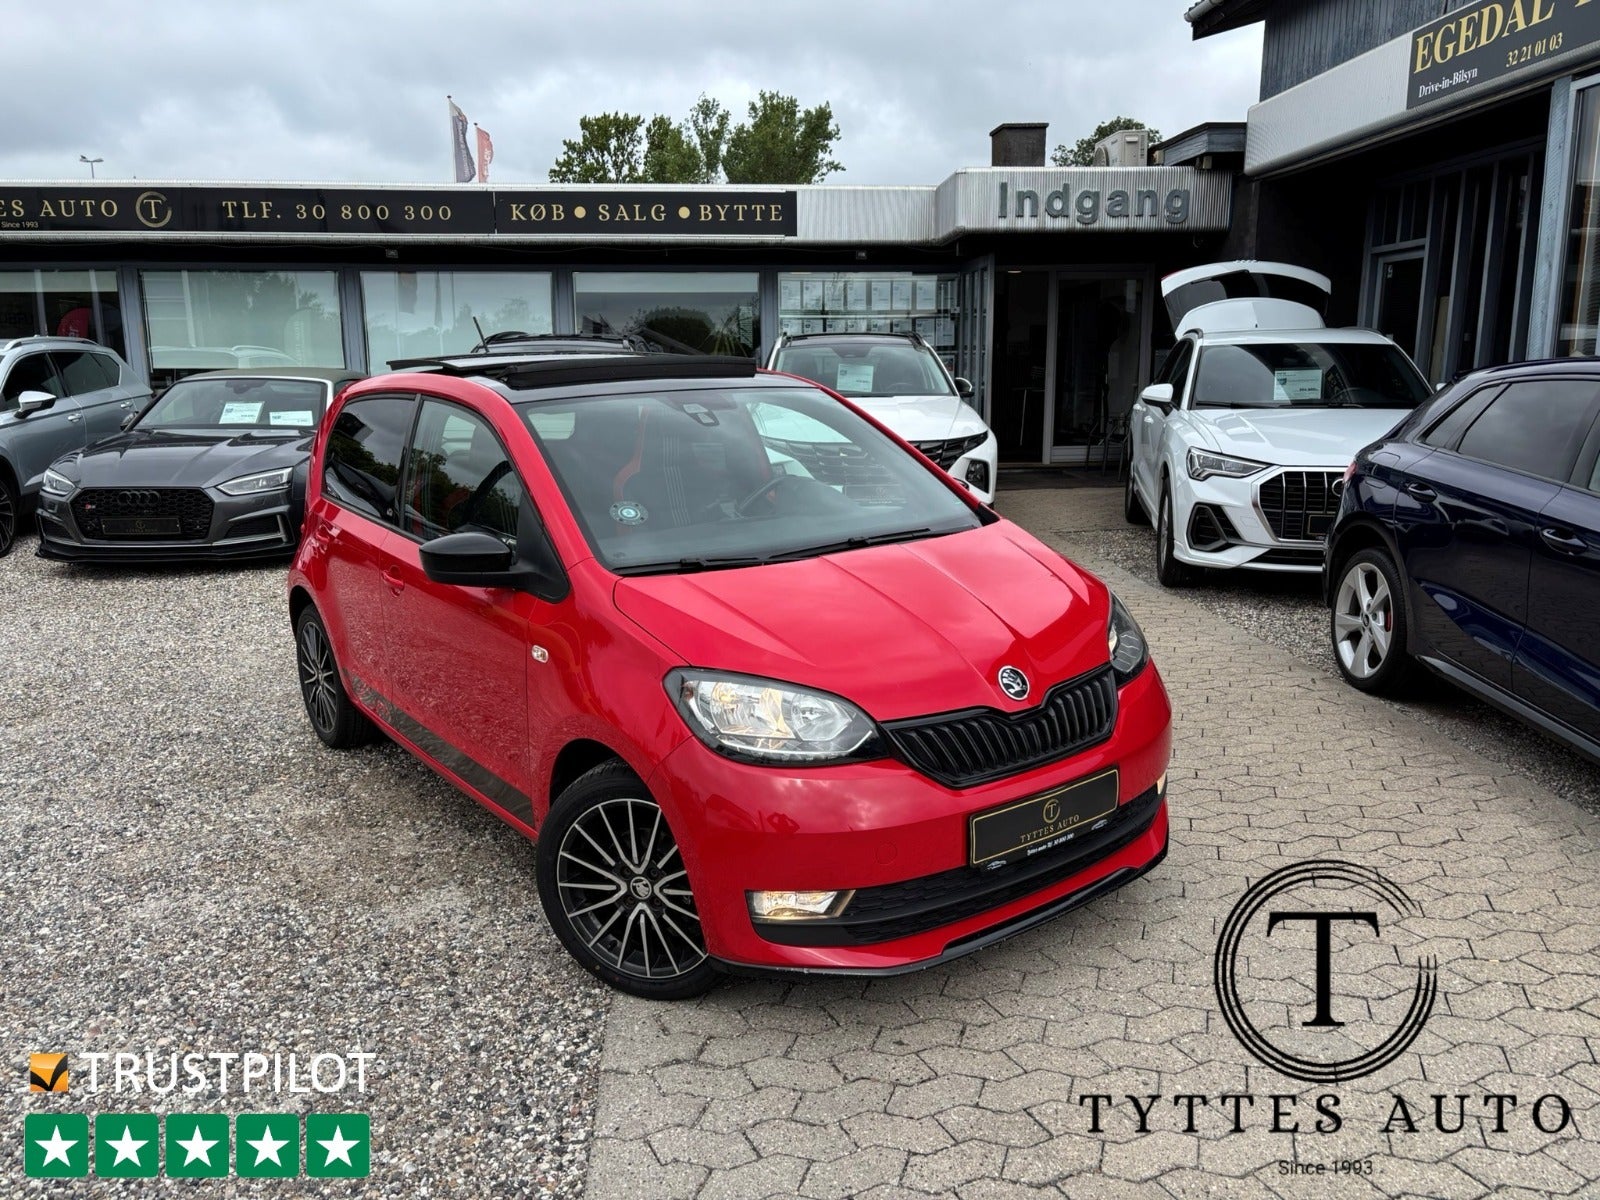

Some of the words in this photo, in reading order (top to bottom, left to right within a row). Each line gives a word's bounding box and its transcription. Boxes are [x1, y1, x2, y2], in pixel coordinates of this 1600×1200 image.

[1413, 0, 1555, 74] EGEDAL
[1505, 49, 1519, 68] 32
[1520, 44, 1532, 62] 21
[1534, 38, 1547, 57] 01
[1549, 31, 1563, 51] 03
[1418, 67, 1478, 98] Drive-in-Bilsyn
[40, 199, 118, 217] AUTO
[222, 201, 281, 219] TLF.
[295, 204, 326, 219] 30
[341, 205, 389, 220] 800
[404, 205, 452, 221] 300
[510, 203, 565, 222] KØB
[598, 203, 667, 222] SALG
[700, 203, 783, 222] BYTTE
[998, 181, 1191, 224] Indgang
[1020, 824, 1054, 843] TYTTES
[1056, 814, 1080, 830] AUTO
